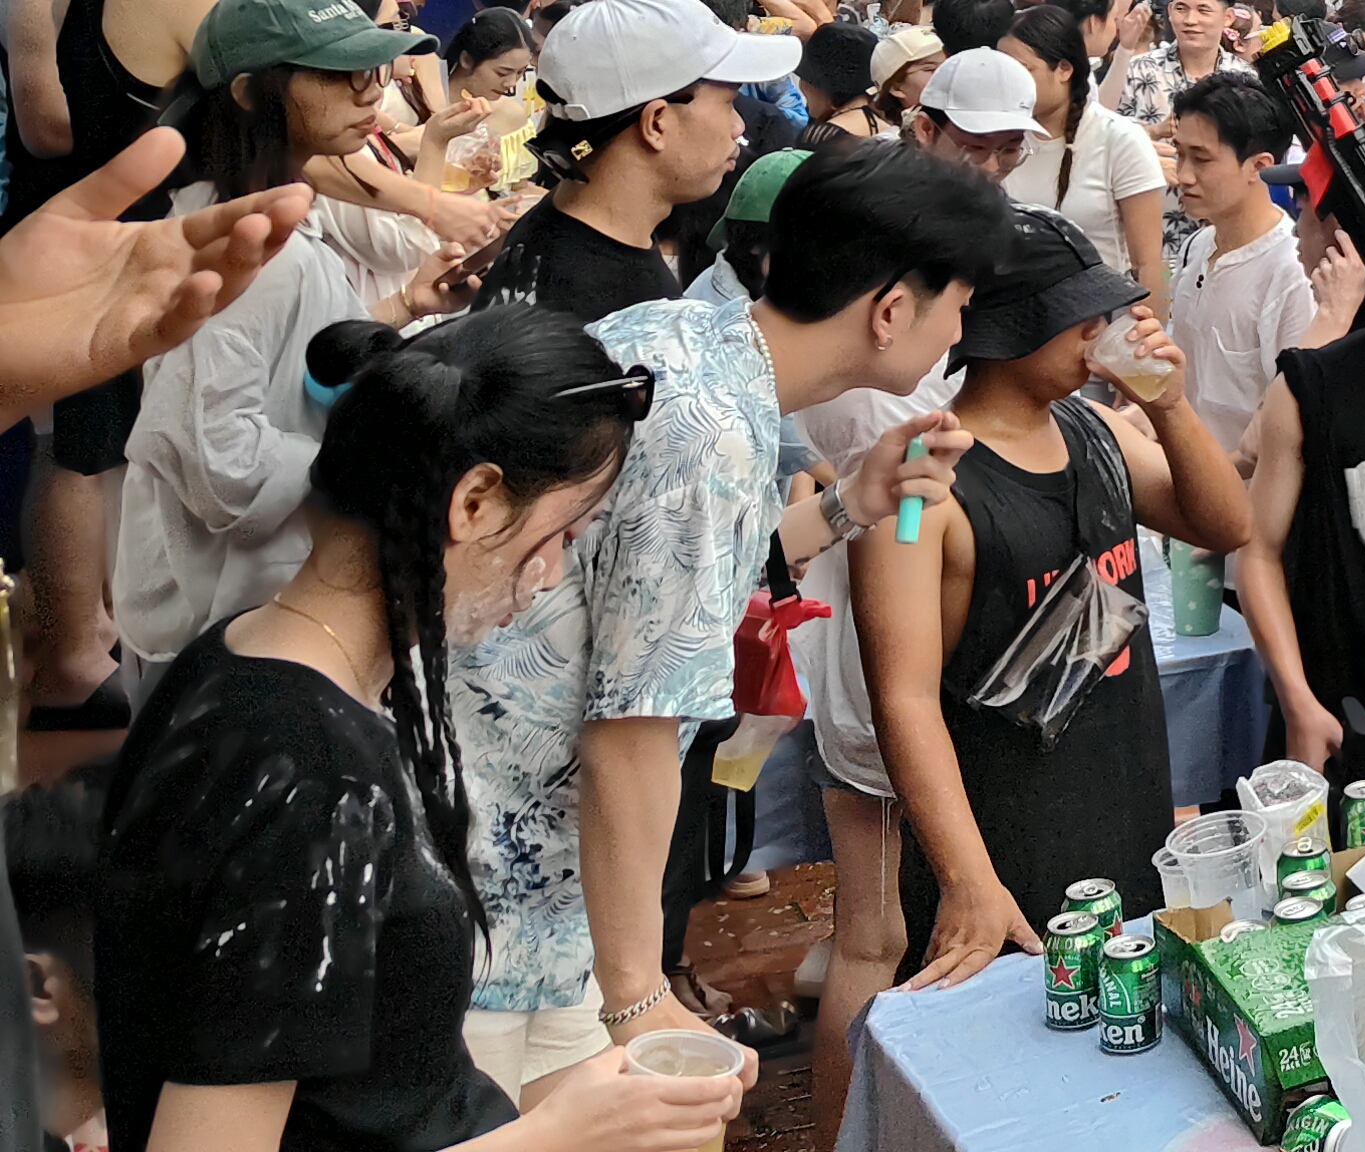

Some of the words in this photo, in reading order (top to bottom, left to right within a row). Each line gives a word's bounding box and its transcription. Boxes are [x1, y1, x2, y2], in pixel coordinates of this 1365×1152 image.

[308, 2, 347, 23] Santa
[1278, 1045, 1299, 1065] 24
[1280, 1060, 1301, 1073] PACK
